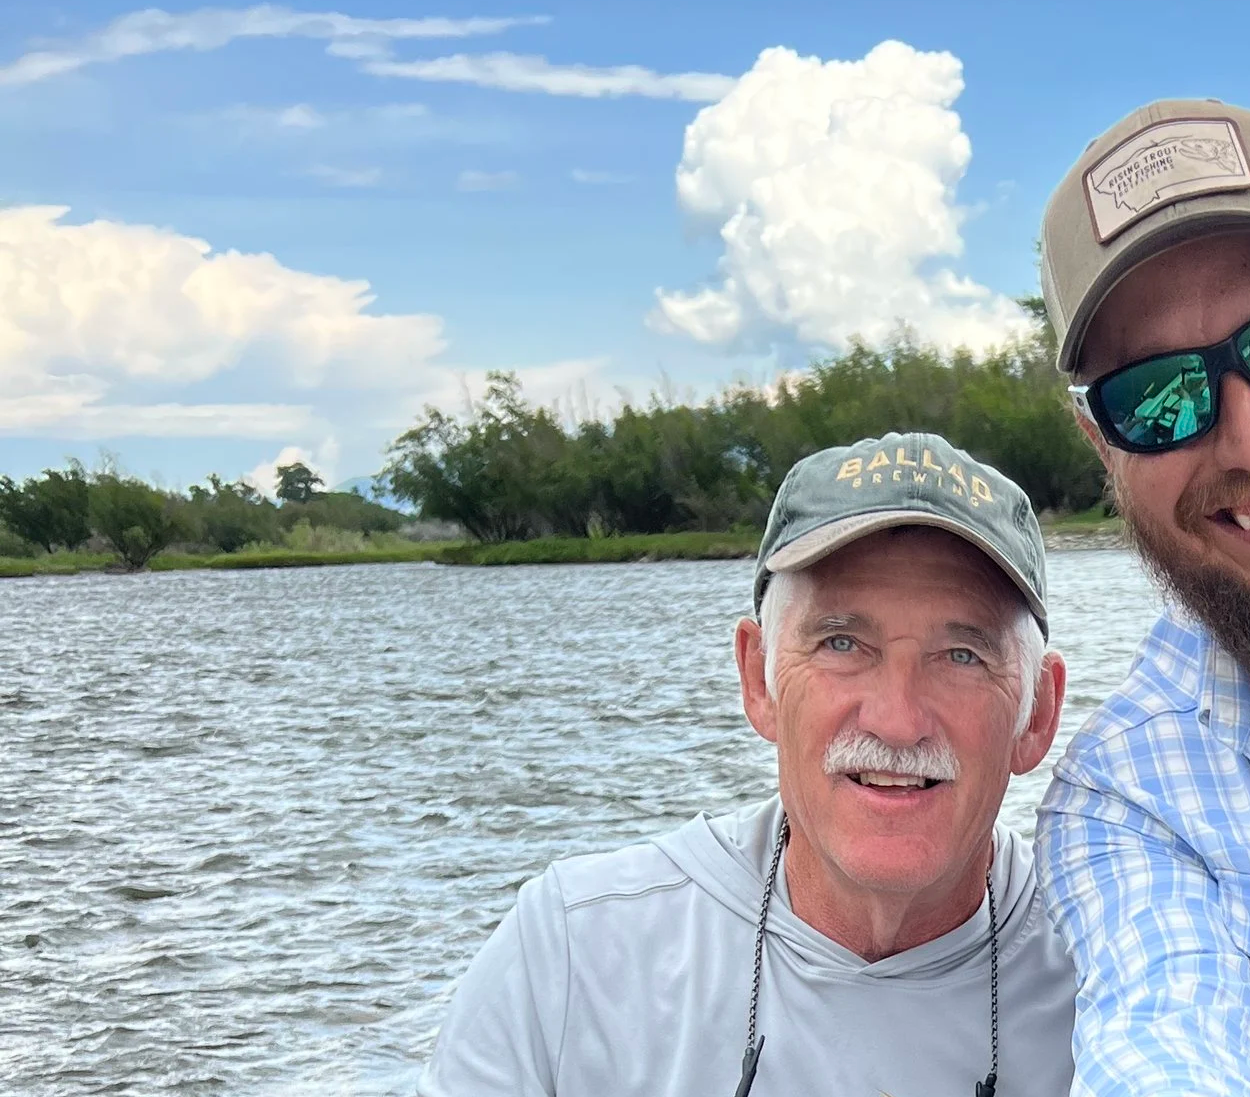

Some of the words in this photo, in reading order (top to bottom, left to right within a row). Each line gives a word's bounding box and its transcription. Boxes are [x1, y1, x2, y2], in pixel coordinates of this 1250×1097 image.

[1108, 162, 1140, 188] RISING
[1144, 145, 1178, 164] TROUT
[1117, 174, 1133, 192] FLY
[1134, 156, 1173, 180] FISHING
[836, 447, 993, 502] BALLAD
[852, 470, 979, 507] BREWING
